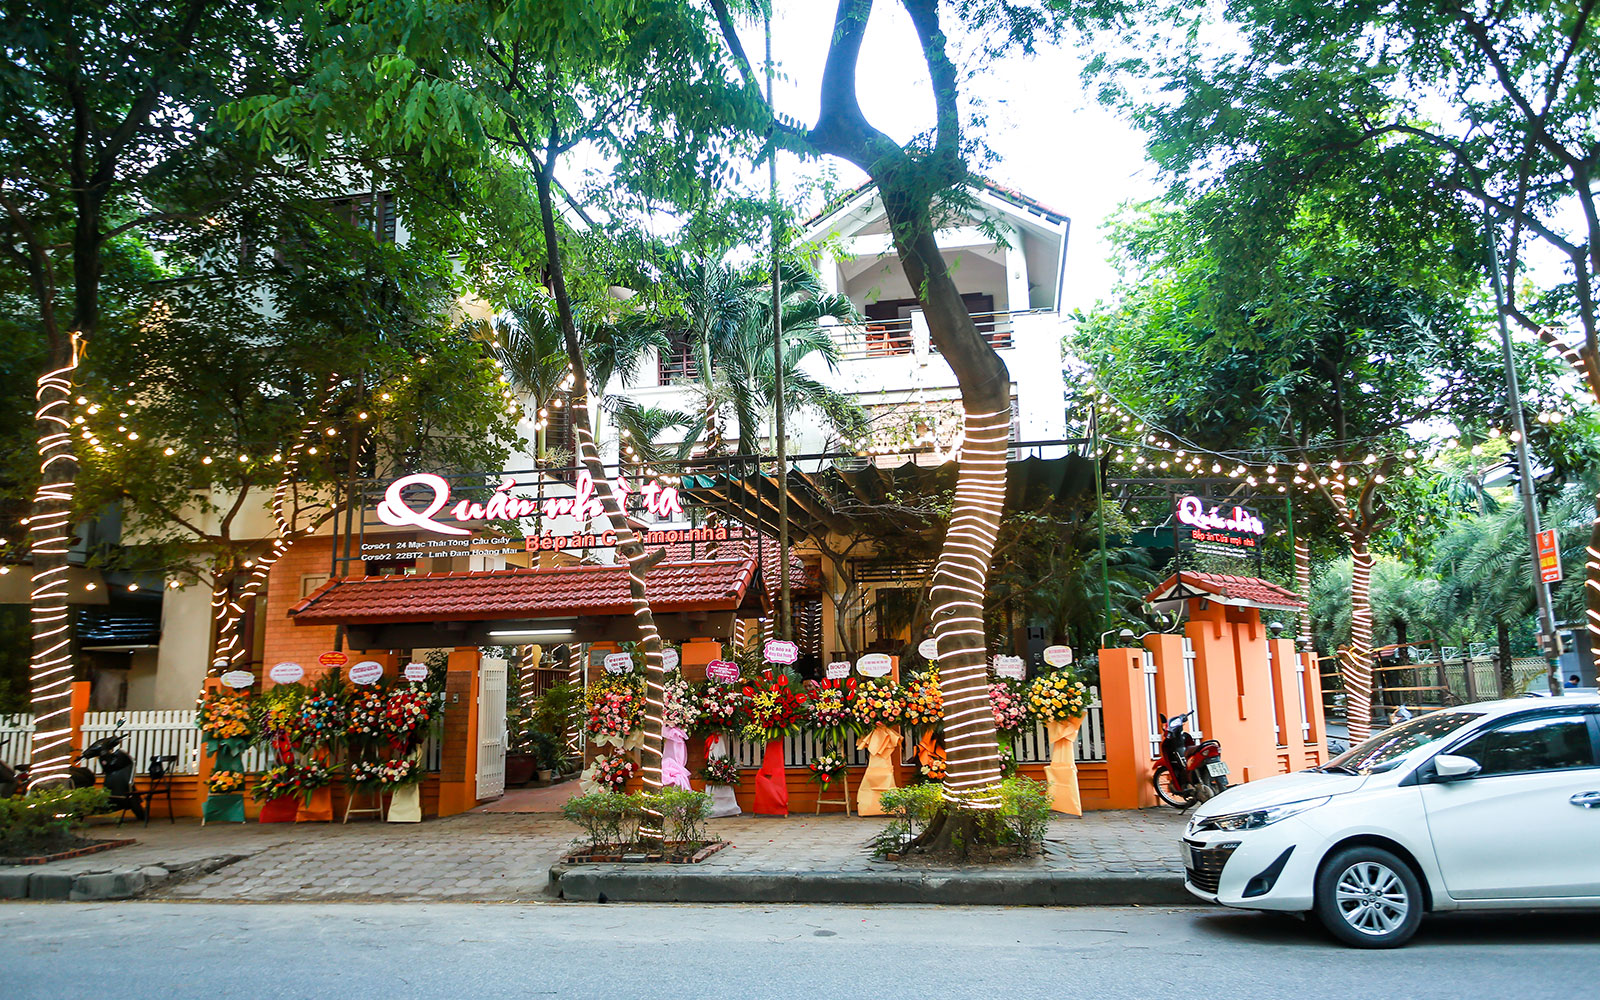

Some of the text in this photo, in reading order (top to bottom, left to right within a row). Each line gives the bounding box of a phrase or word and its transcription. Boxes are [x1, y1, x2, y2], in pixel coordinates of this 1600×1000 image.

[377, 472, 537, 536] Quán
[640, 480, 684, 517] ta
[396, 541, 407, 549] 24
[408, 541, 426, 549] Mạc
[525, 528, 567, 552] Bếp
[571, 530, 596, 548] ăn
[646, 529, 684, 546] mọi
[689, 522, 728, 542] nhà
